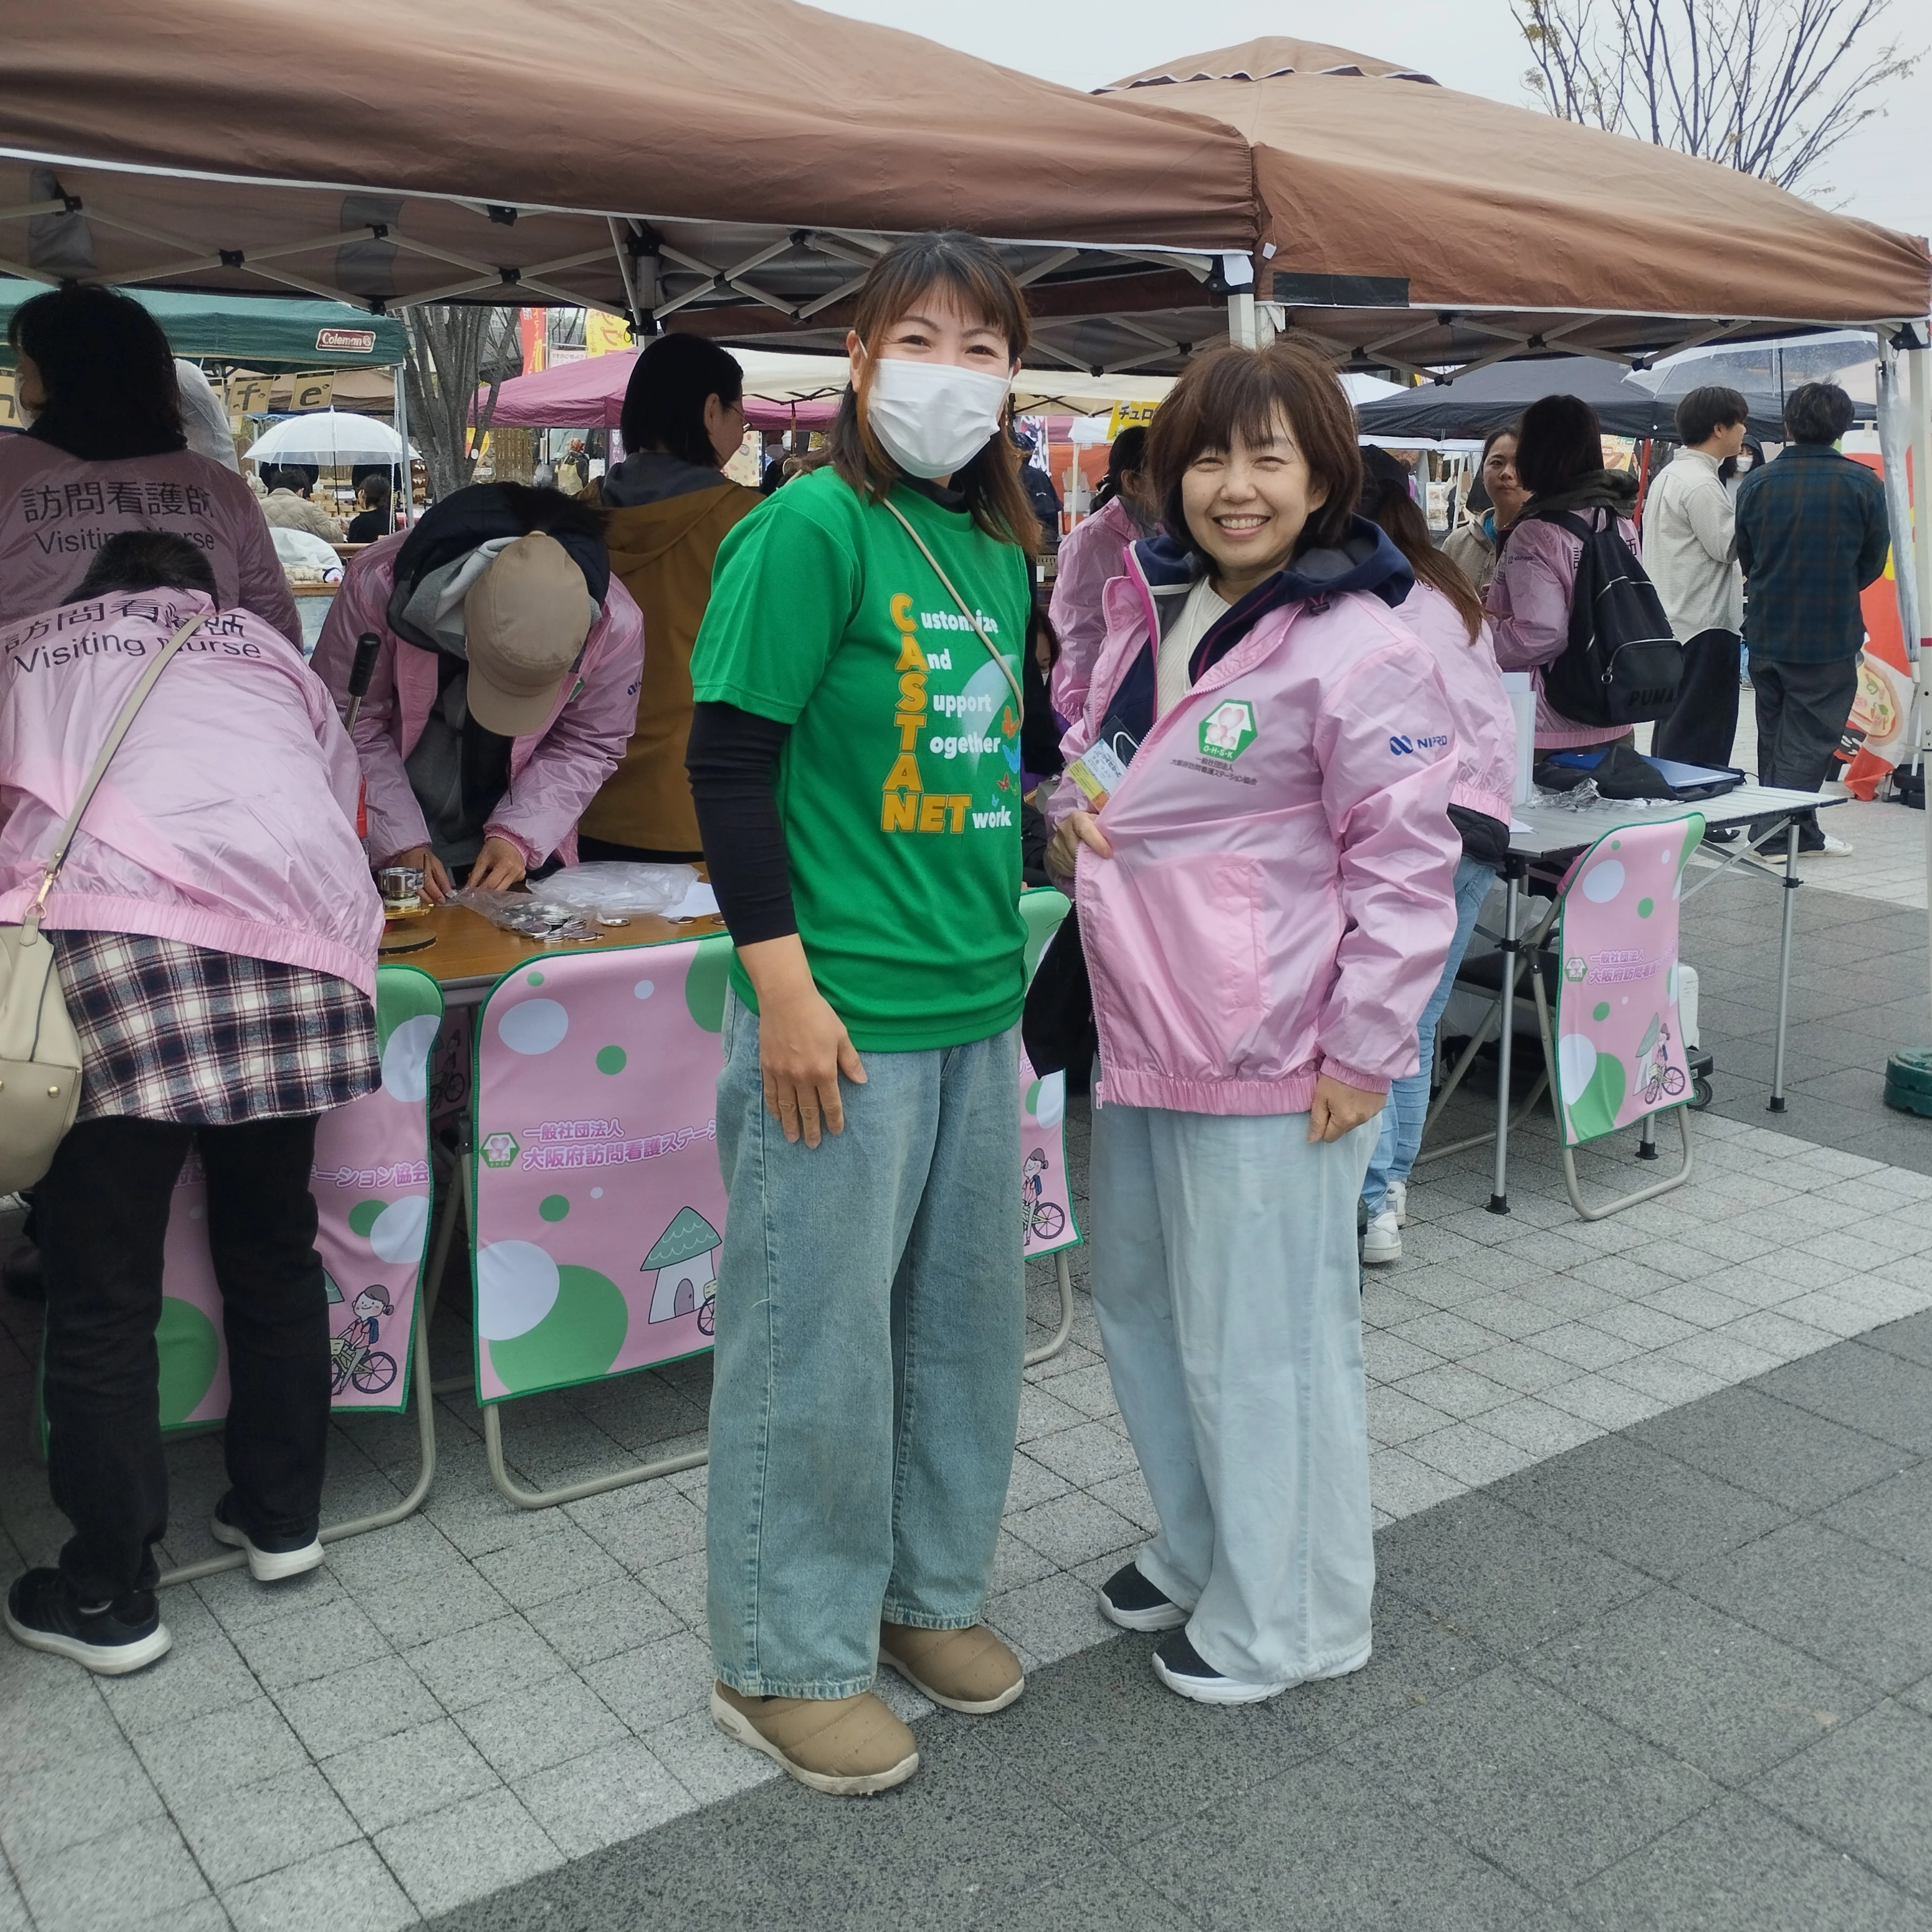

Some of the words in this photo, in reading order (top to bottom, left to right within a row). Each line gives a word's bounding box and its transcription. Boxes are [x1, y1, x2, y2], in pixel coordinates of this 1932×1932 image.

[322, 332, 362, 346] Coleman
[300, 387, 322, 406] e
[21, 481, 215, 523] 訪問看護師
[35, 527, 117, 555] Visiti
[14, 632, 146, 673] Visiting
[1589, 948, 1645, 966] 一般社団法人
[522, 1118, 625, 1143] 一般社団法人
